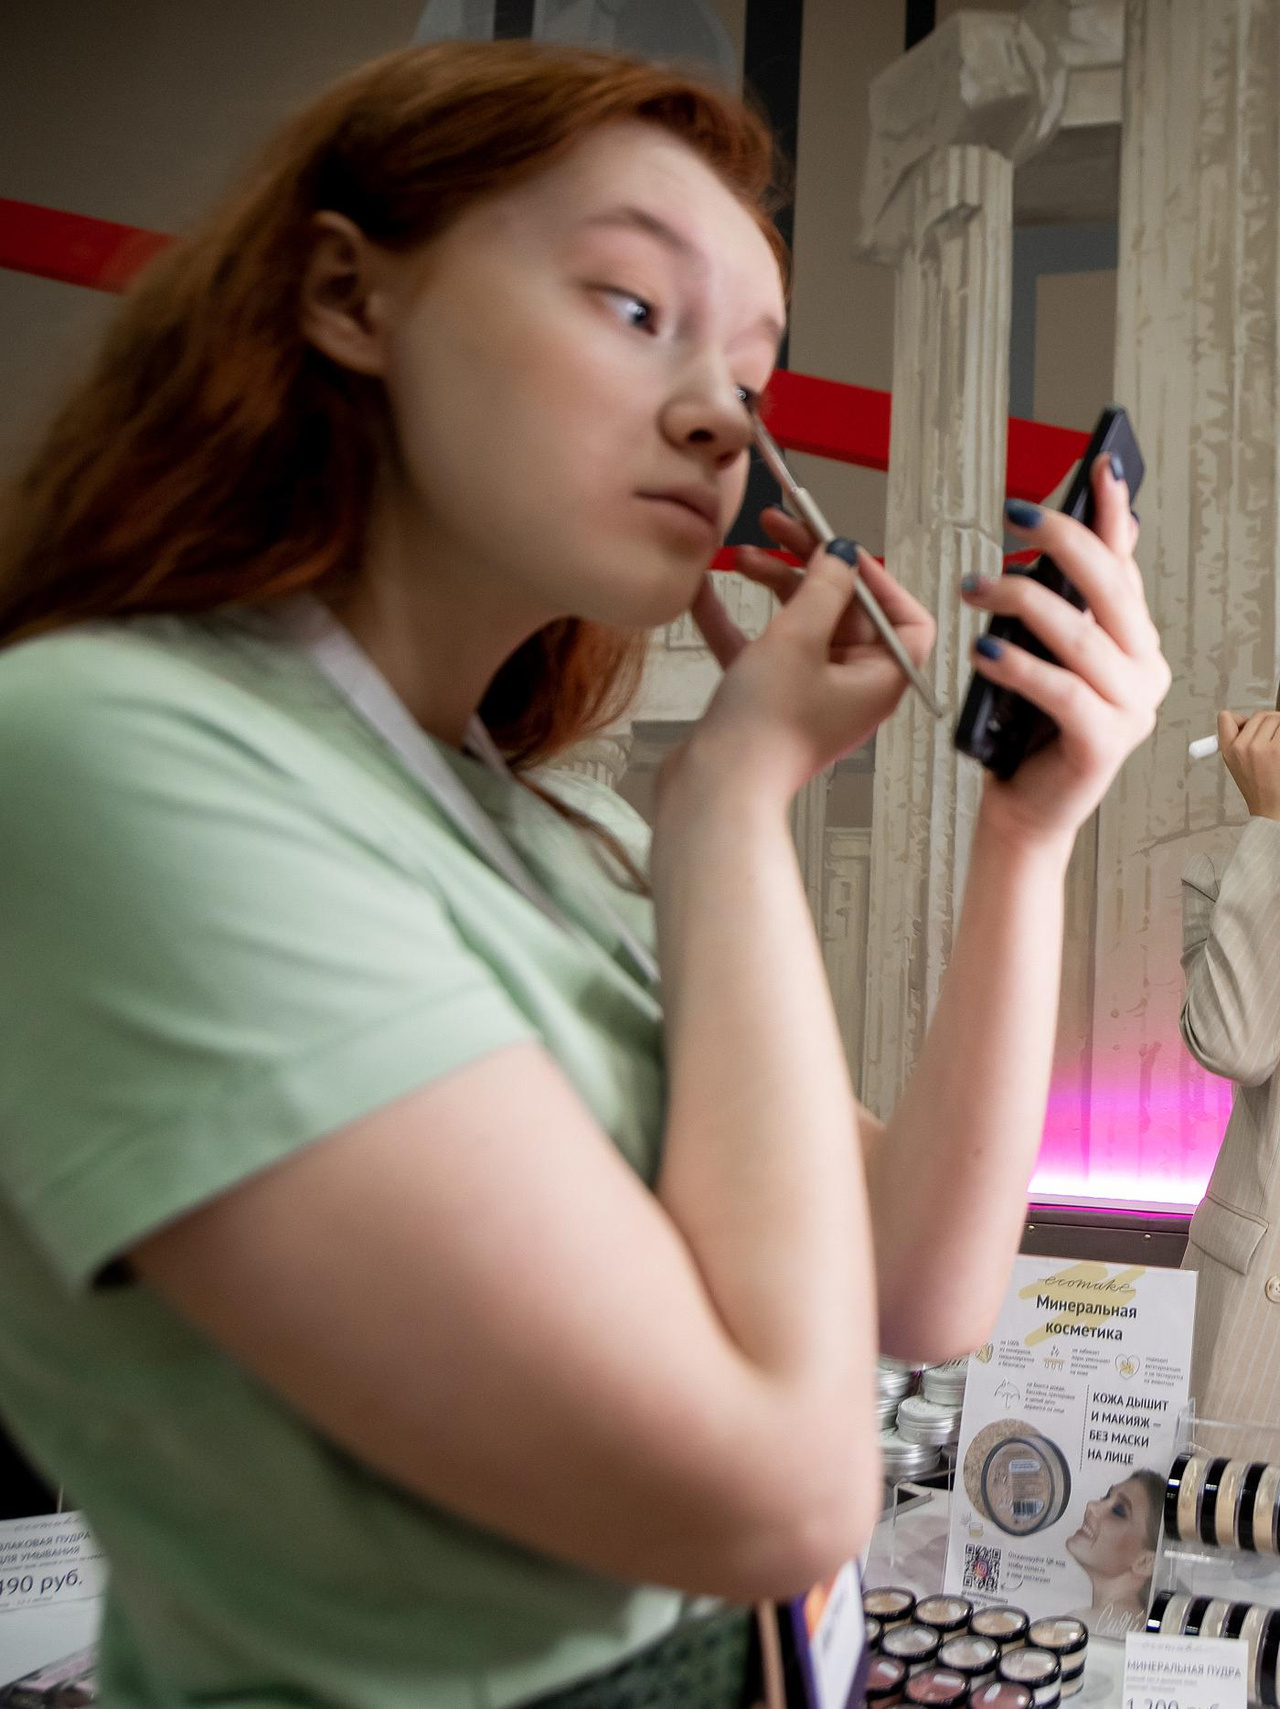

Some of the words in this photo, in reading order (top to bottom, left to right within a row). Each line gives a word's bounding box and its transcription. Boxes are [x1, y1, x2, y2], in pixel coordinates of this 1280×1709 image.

[1036, 1294, 1138, 1319] Минеральная
[1045, 1321, 1123, 1341] косметика
[1093, 1391, 1124, 1406] КОЖА
[1126, 1396, 1169, 1411] ДЫШИТ
[1091, 1410, 1099, 1421] И
[1101, 1412, 1150, 1428] МАКИЯЖ
[1089, 1429, 1108, 1443] БЕЗ
[1111, 1431, 1149, 1448] МАСКИ
[1087, 1448, 1102, 1461] НА
[1104, 1450, 1134, 1465] ЛИЦЕ
[40, 1568, 82, 1595] руб.
[1127, 1660, 1204, 1676] МИНЕРАЛЬНАЯ
[1207, 1664, 1242, 1678] ПУДРА
